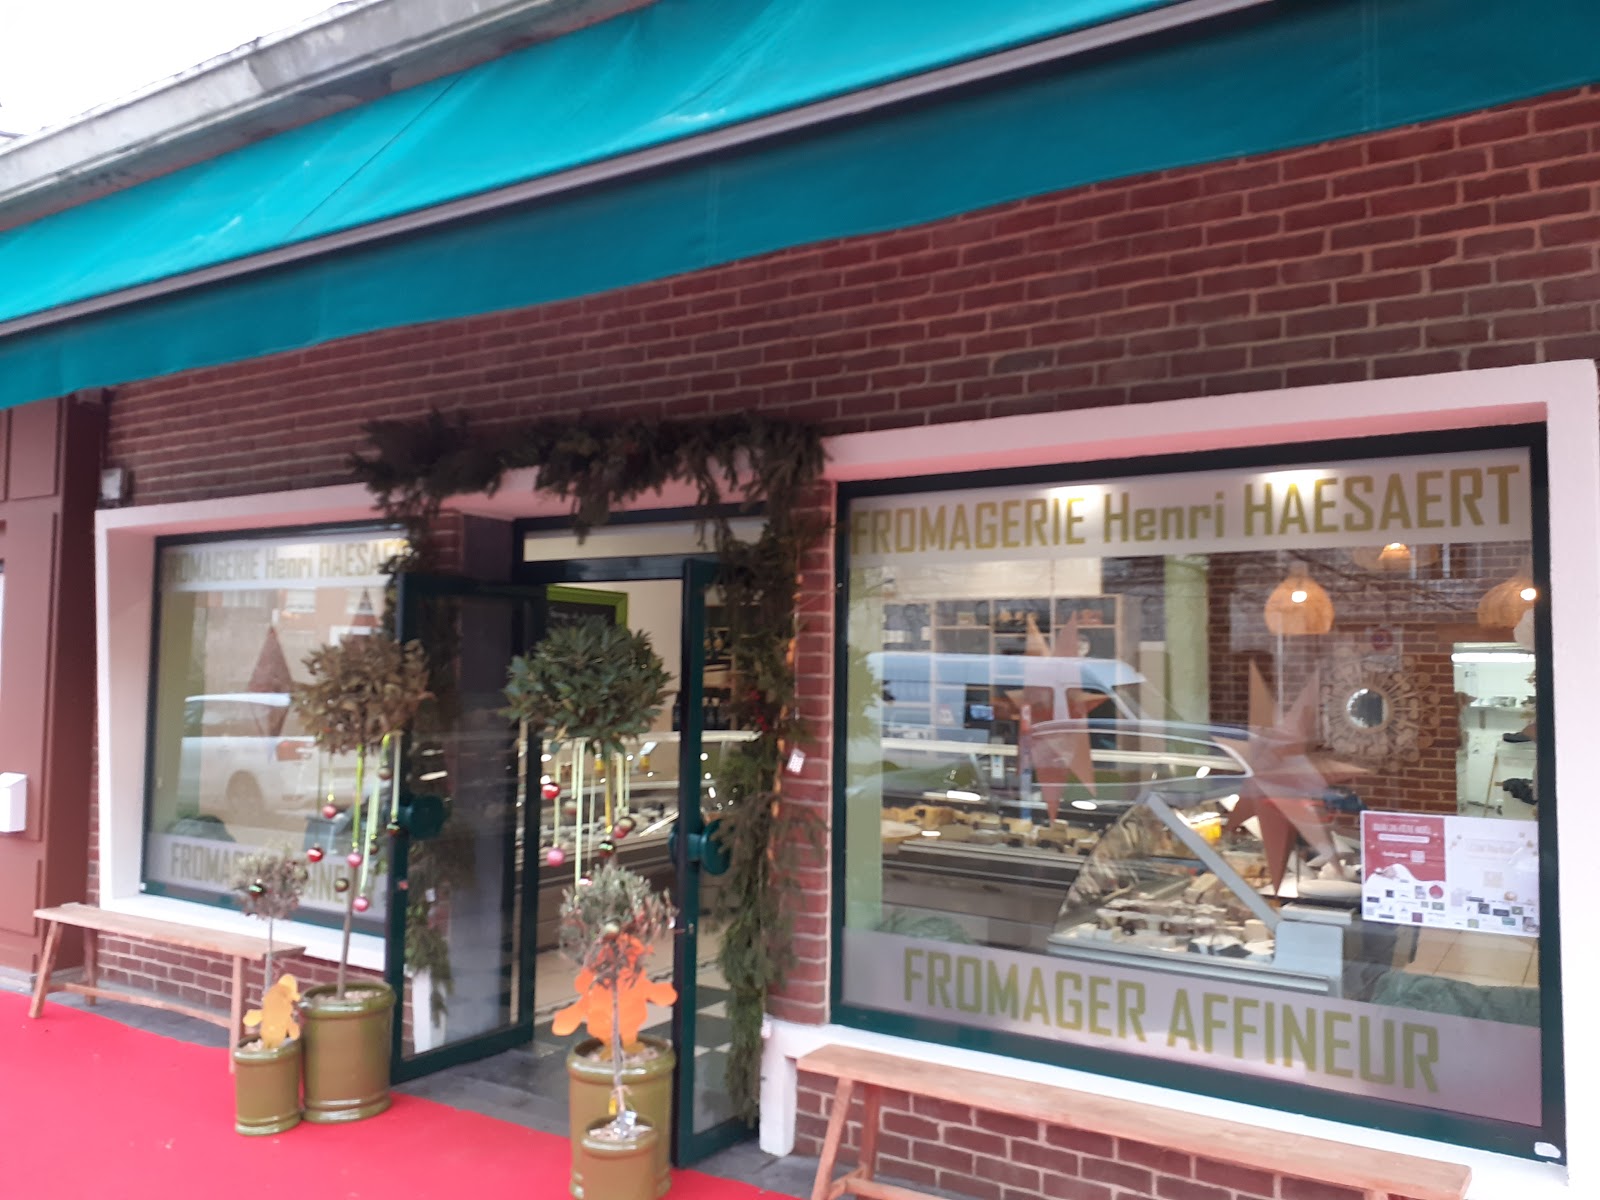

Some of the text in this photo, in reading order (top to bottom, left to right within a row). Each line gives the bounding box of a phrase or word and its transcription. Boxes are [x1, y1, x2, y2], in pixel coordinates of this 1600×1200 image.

[851, 464, 1521, 554] FROMAGERIE Henri HAESAERT
[903, 946, 1439, 1093] FROMAGER AFFINEUR
